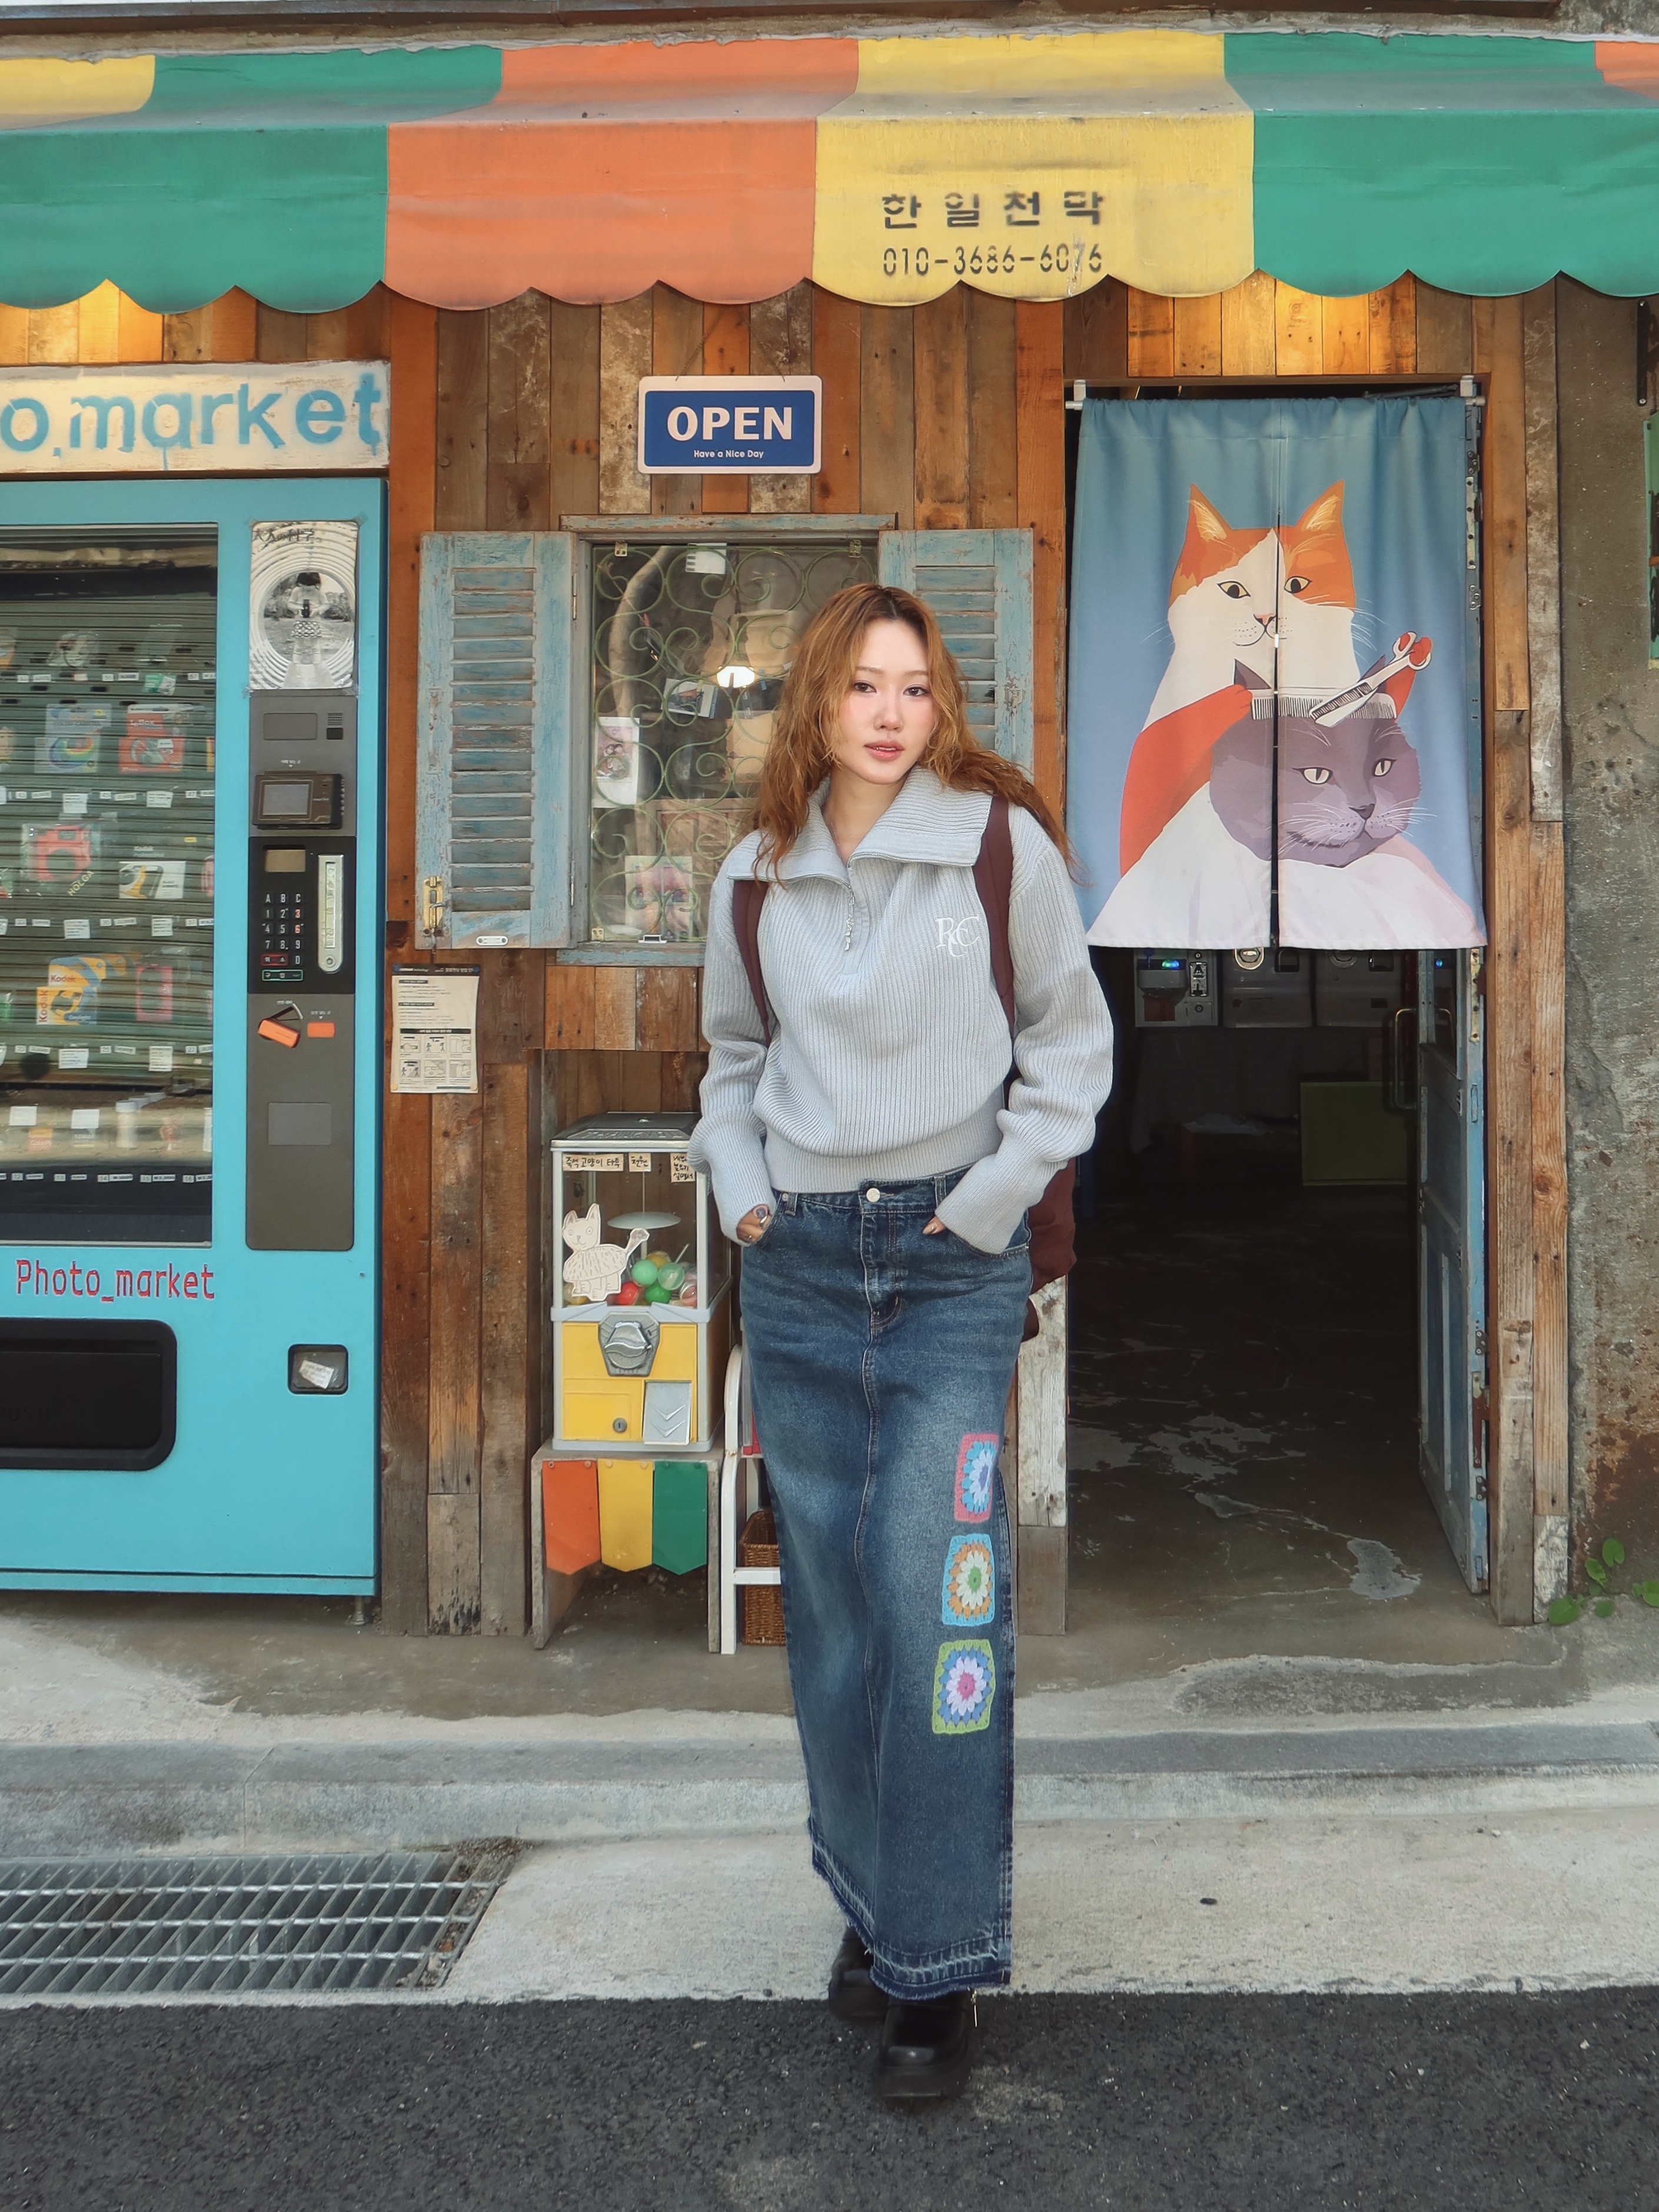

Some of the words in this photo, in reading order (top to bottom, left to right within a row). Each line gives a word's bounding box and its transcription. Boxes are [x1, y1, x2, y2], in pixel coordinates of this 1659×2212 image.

[883, 243, 1103, 277] 010-3686-6076
[667, 406, 793, 441] OPEN
[694, 450, 715, 458] Have
[725, 449, 745, 458] Nice
[747, 450, 764, 459] Day
[67, 871, 94, 896] HOLGA
[265, 894, 271, 903] A
[280, 894, 286, 903] B
[295, 894, 301, 903] C
[267, 909, 270, 918] 1
[280, 909, 285, 918] 2
[295, 909, 301, 918] 3
[265, 924, 270, 934] 4
[280, 924, 285, 934] 5
[295, 924, 300, 934] 6
[265, 940, 271, 949] 7
[280, 940, 285, 949] 8
[295, 940, 301, 949] 9
[51, 974, 77, 982] Kodak
[38, 989, 48, 1023] Kodak
[566, 1157, 579, 1168] 즉석
[580, 1157, 603, 1167] 고양이
[631, 1155, 649, 1167] 천원
[16, 1259, 215, 1303] Photo_market
